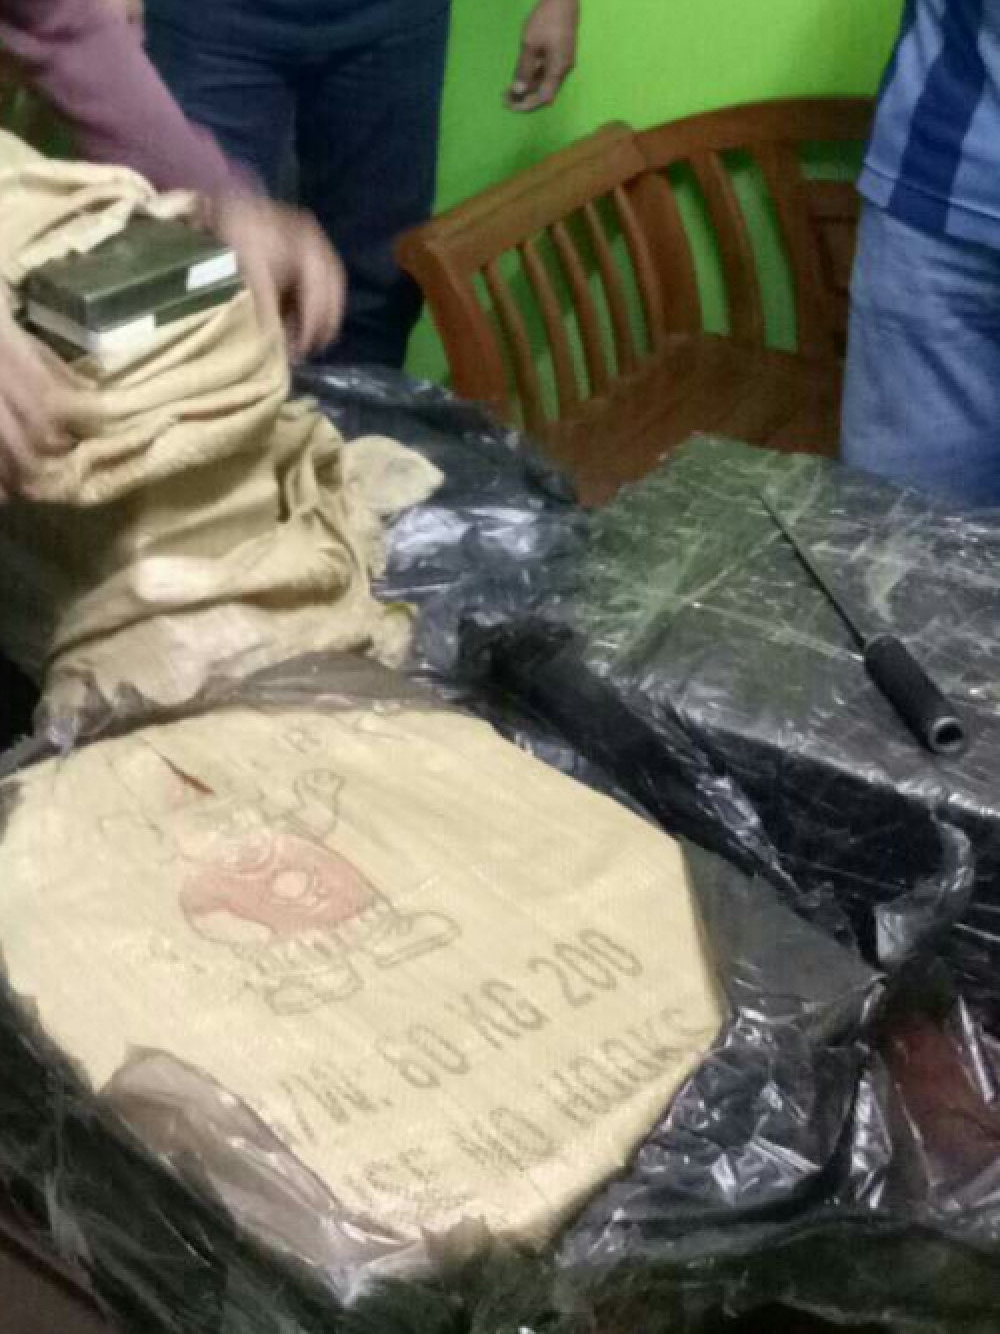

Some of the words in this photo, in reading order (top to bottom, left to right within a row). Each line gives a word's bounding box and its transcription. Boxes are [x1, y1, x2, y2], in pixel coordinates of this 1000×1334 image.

[376, 1022, 472, 1090] 60
[444, 977, 552, 1051] KG
[530, 927, 645, 1009] 200
